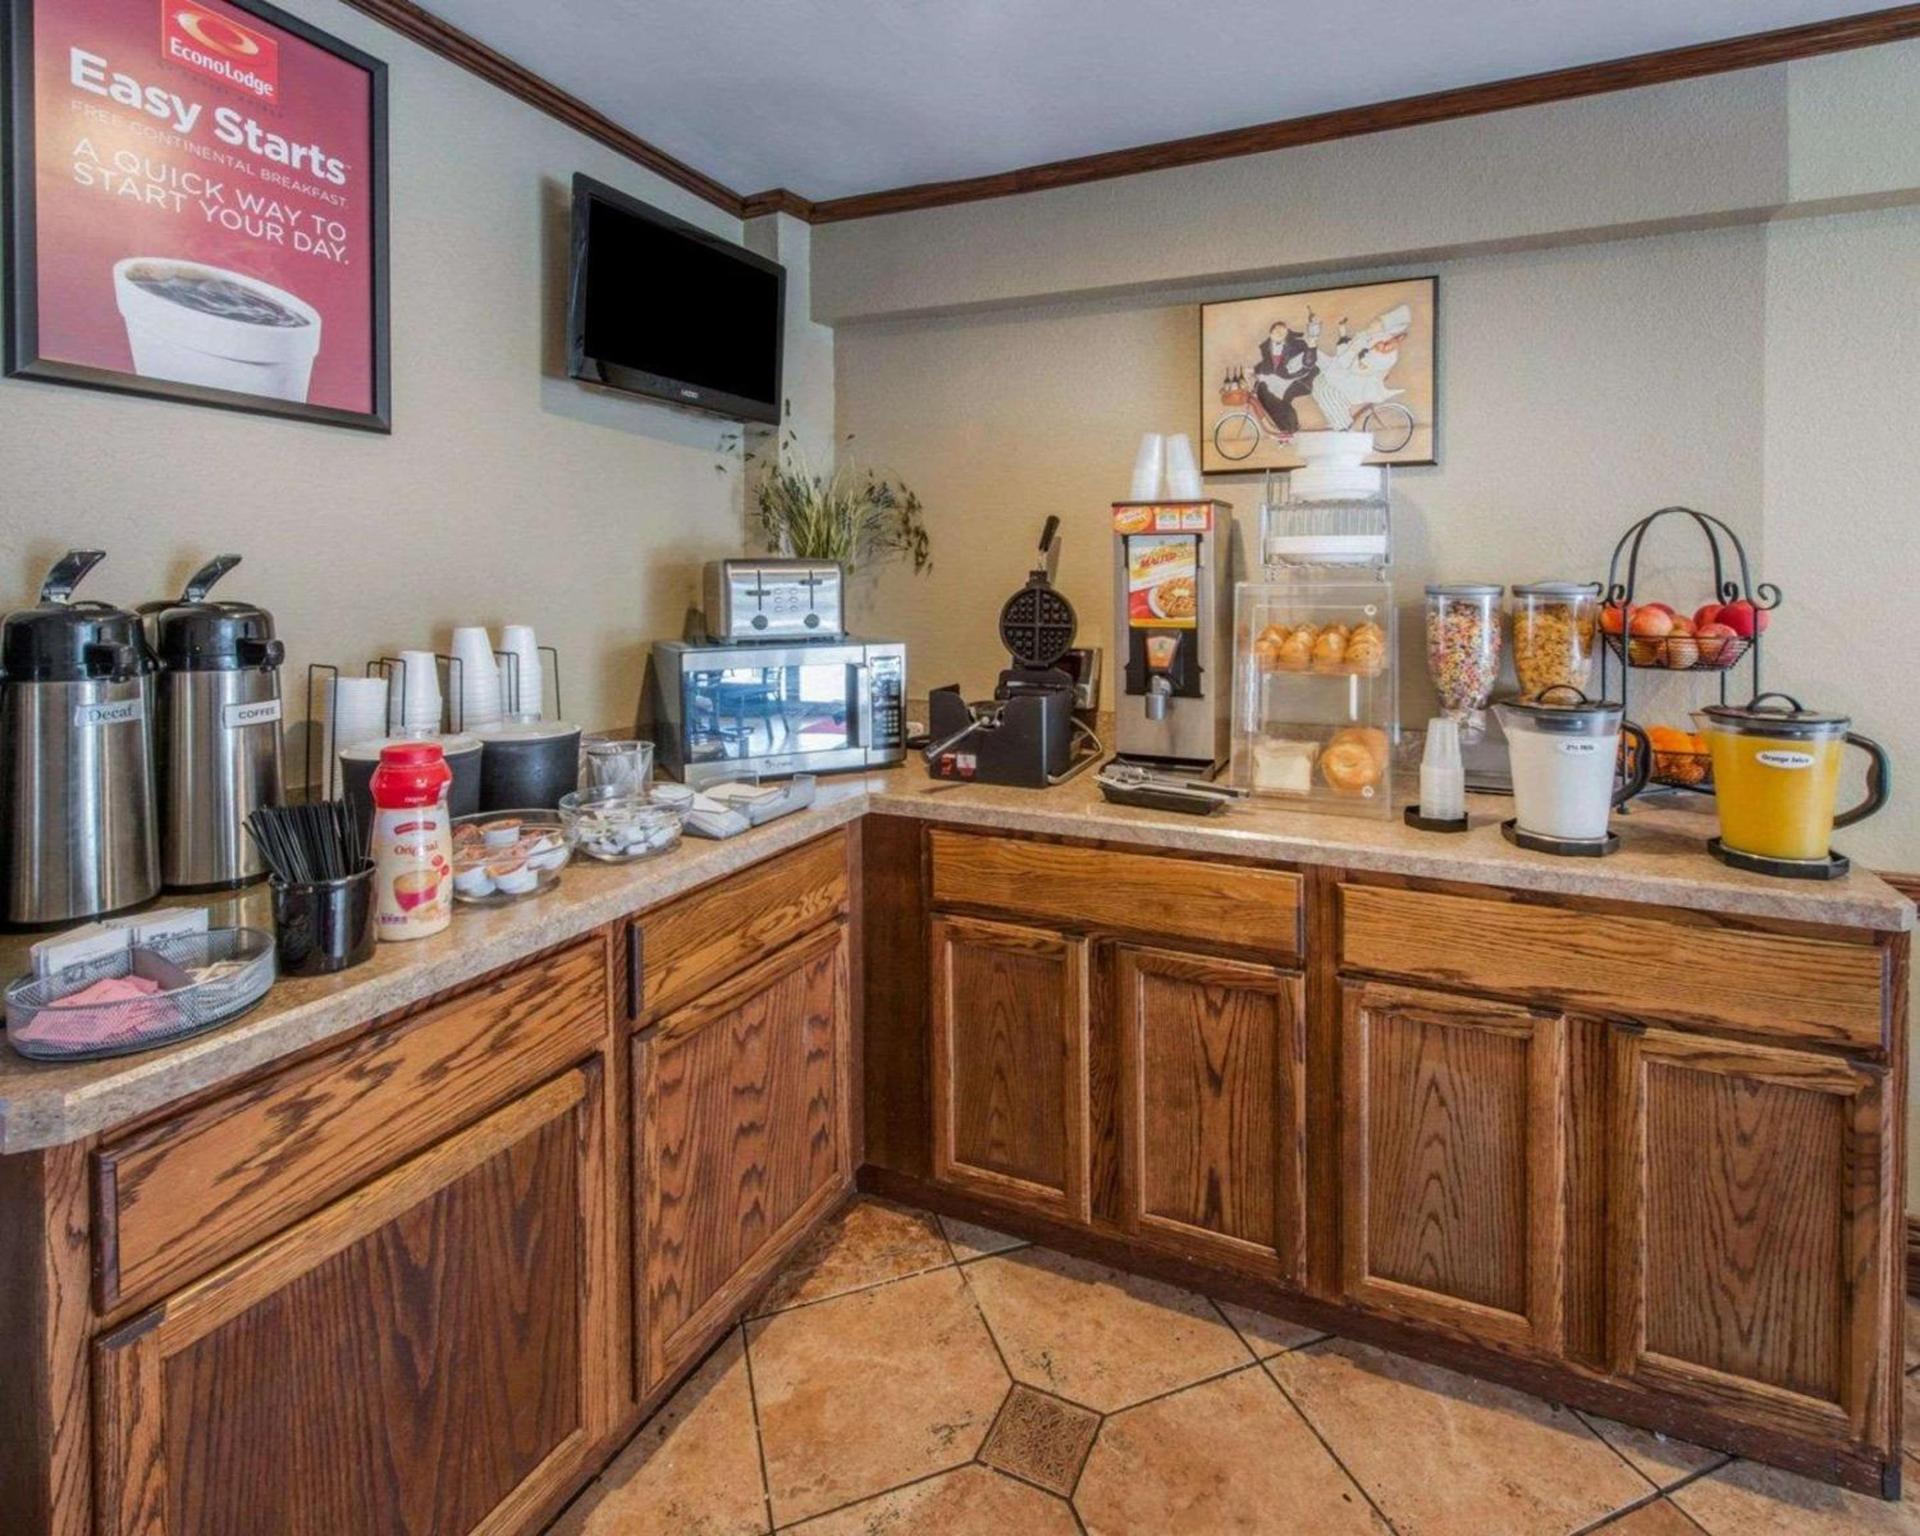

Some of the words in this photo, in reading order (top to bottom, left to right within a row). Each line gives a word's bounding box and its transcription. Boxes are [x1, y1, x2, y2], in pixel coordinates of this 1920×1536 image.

[169, 36, 275, 98] EconoLodge
[69, 47, 202, 134] Easy
[213, 106, 348, 186] Starts
[72, 99, 119, 124] FREE
[131, 121, 255, 176] CONTINENTAL
[260, 167, 347, 208] BREAKFAST
[73, 137, 99, 163] A
[114, 150, 225, 204] QUICK
[235, 188, 302, 227] WAY
[311, 213, 347, 242] TO
[73, 161, 187, 213] START
[199, 199, 284, 245] YOUR
[294, 230, 350, 265] DAY.
[88, 704, 133, 722] Decaf
[238, 706, 276, 720] COFFEE
[1761, 753, 1789, 764] Orange
[393, 841, 439, 858] Orignal
